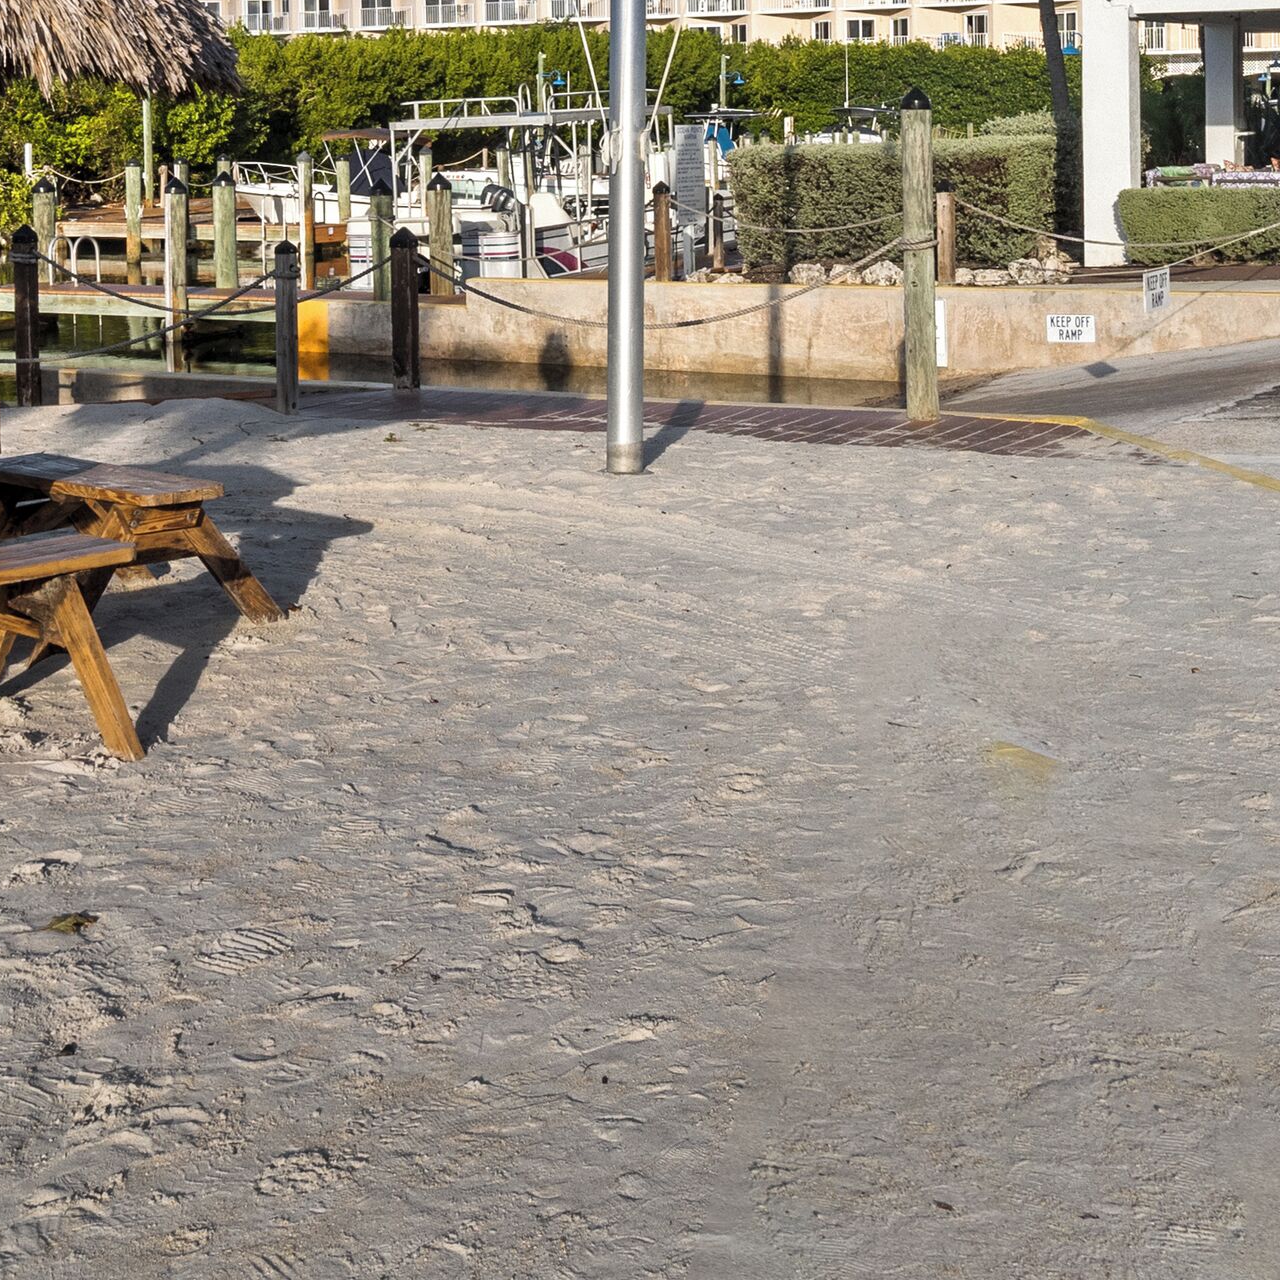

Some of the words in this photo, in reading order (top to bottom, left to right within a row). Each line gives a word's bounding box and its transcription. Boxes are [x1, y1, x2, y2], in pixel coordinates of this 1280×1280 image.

[1147, 274, 1158, 291] KEEP
[1159, 272, 1168, 289] OFF
[1152, 290, 1164, 308] RAMP
[1050, 316, 1071, 328] KEEP
[1074, 316, 1091, 328] OFF
[1058, 329, 1083, 341] RAMP
